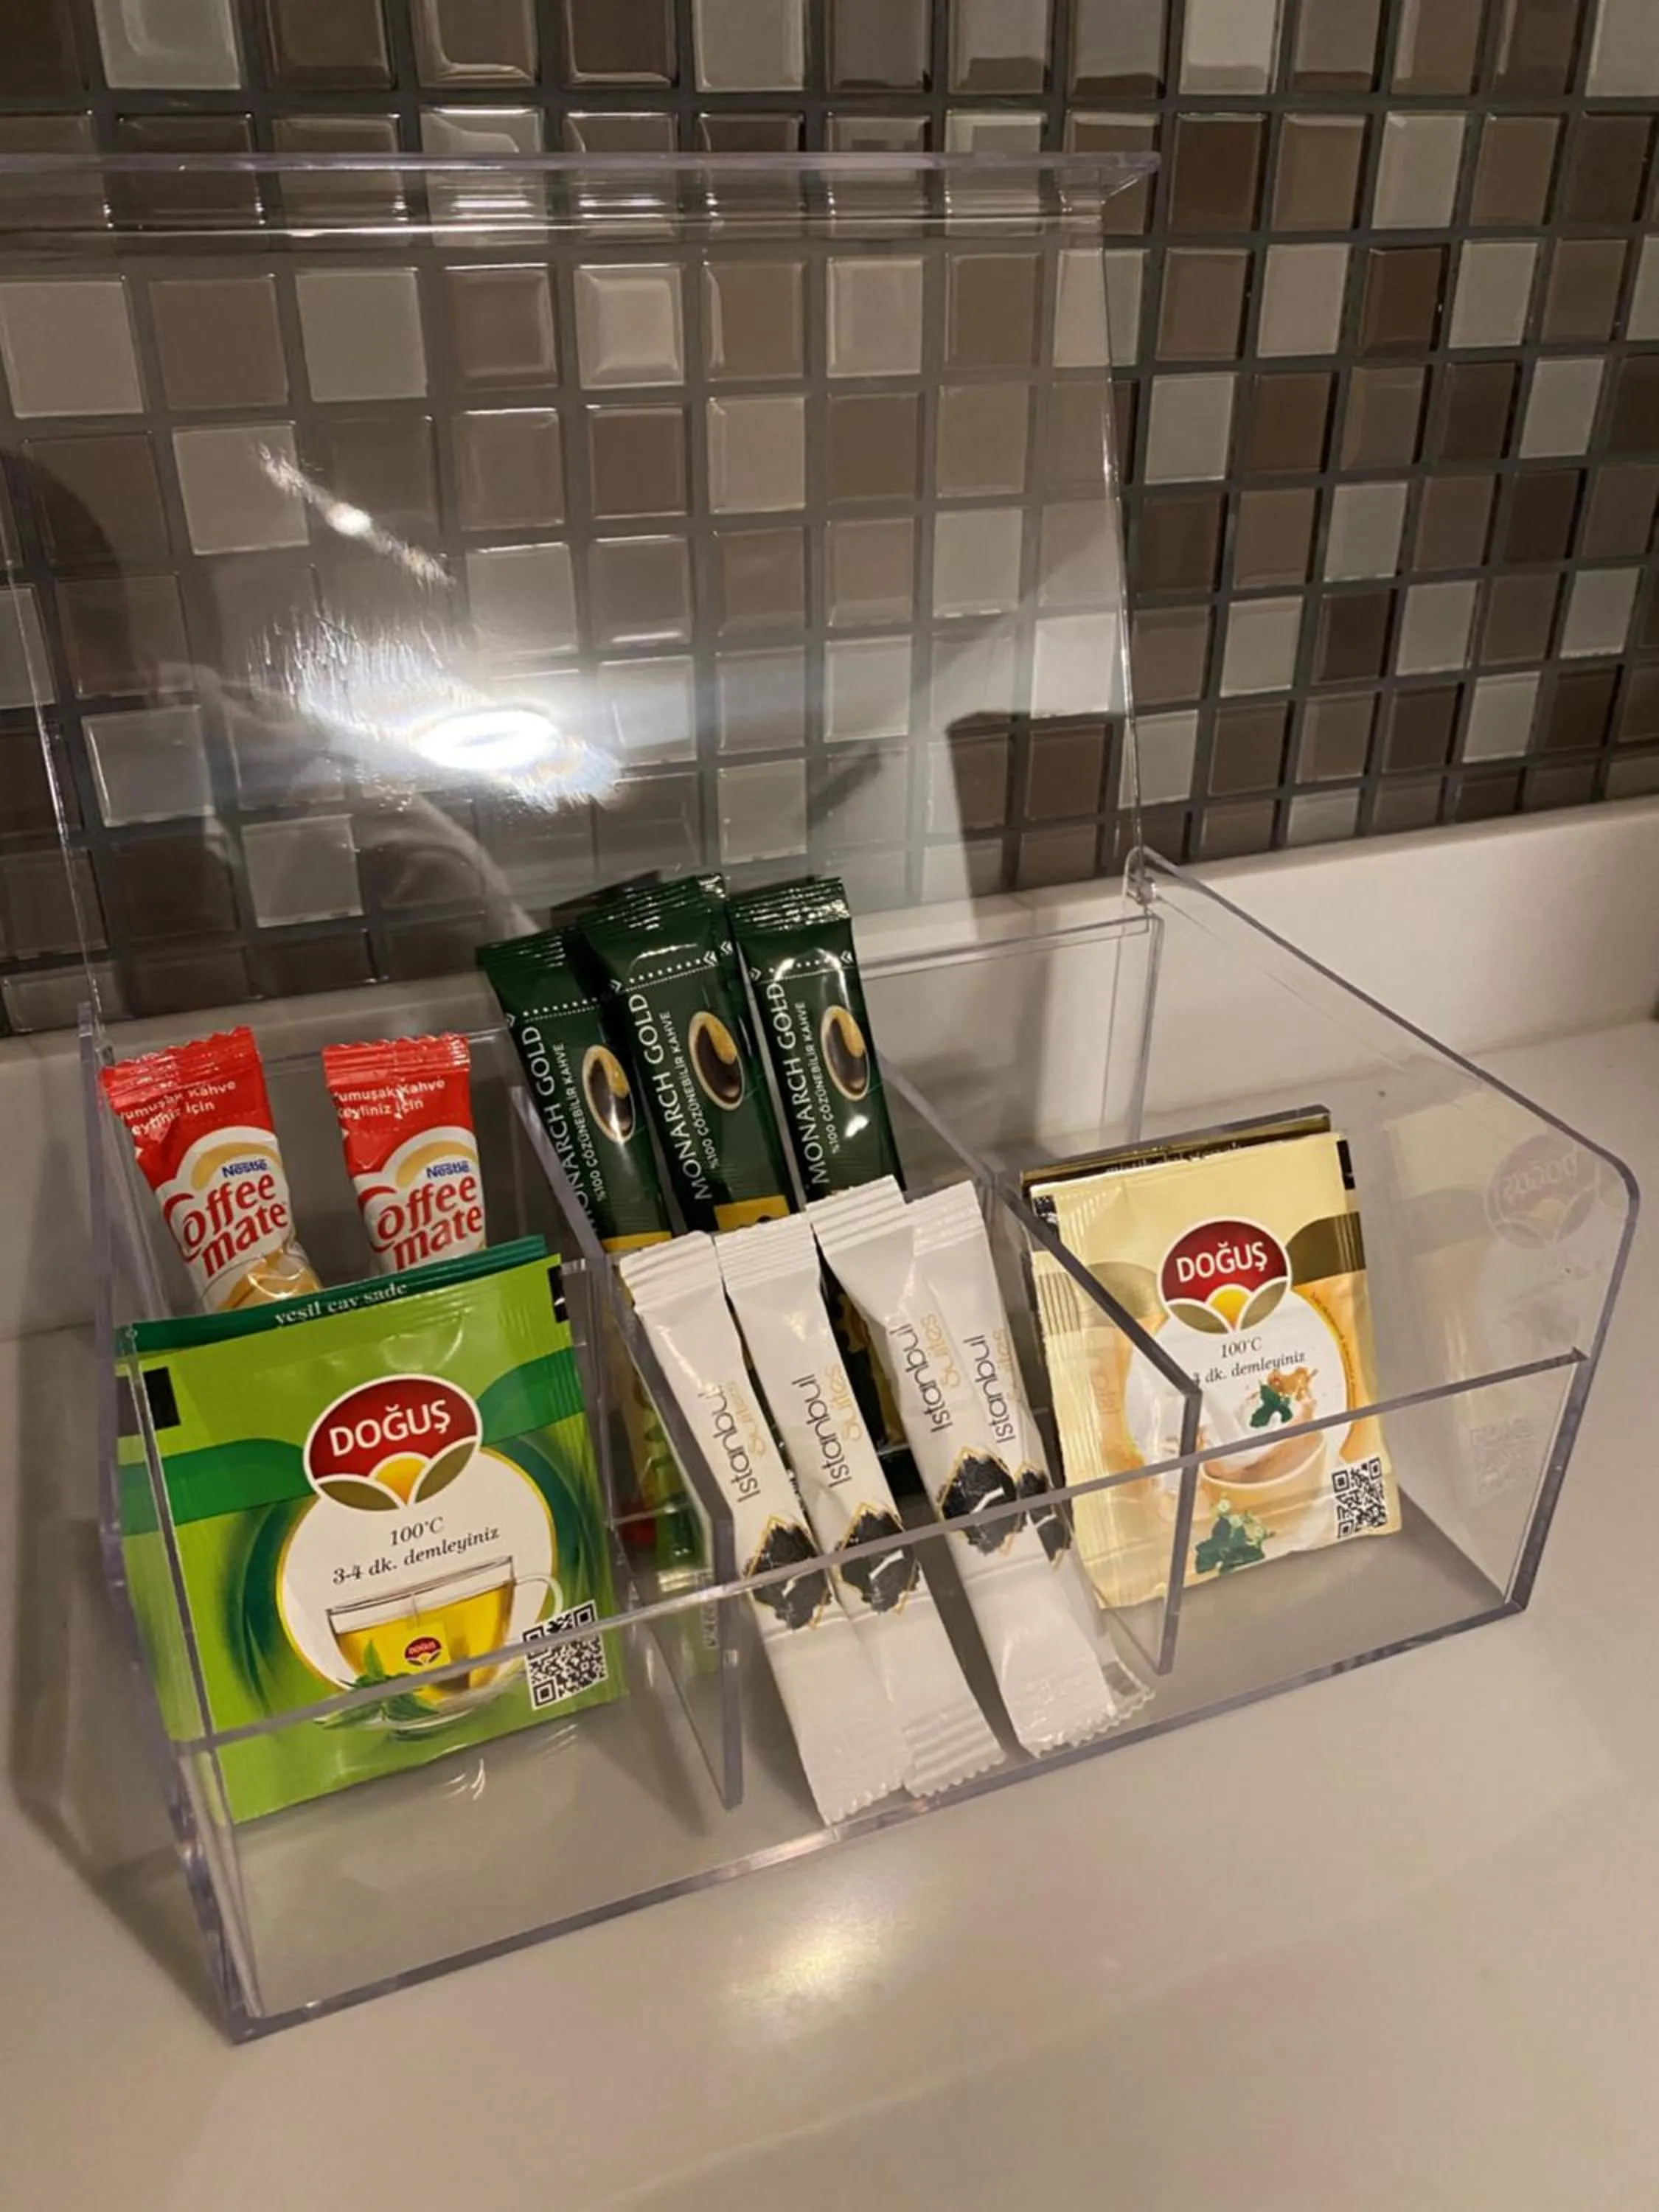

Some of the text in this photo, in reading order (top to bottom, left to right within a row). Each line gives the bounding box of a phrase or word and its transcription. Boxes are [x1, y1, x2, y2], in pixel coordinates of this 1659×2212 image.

[659, 1011, 683, 1054] KAHVE
[795, 1003, 813, 1043] KAHVE
[553, 1043, 575, 1083] KAHVE
[628, 993, 713, 1200] MONARCH GOLD
[766, 982, 830, 1184] MONARCH GOLD
[521, 1026, 599, 1234] ONARCH GOLD
[164, 1174, 276, 1263] Coffee
[201, 1203, 288, 1278] mate
[358, 1175, 477, 1253] Coffee
[393, 1205, 482, 1270] mate
[1176, 1241, 1267, 1282] DOĞUŞ
[889, 1324, 953, 1433] Istanbul
[963, 1335, 1015, 1443] Istanbul
[1231, 1350, 1305, 1377] demleyiniz
[330, 1399, 451, 1457] DOĞUŞ
[791, 1374, 852, 1488] Istanbul
[333, 1527, 500, 1585] 3-4 dk. demleyiniz
